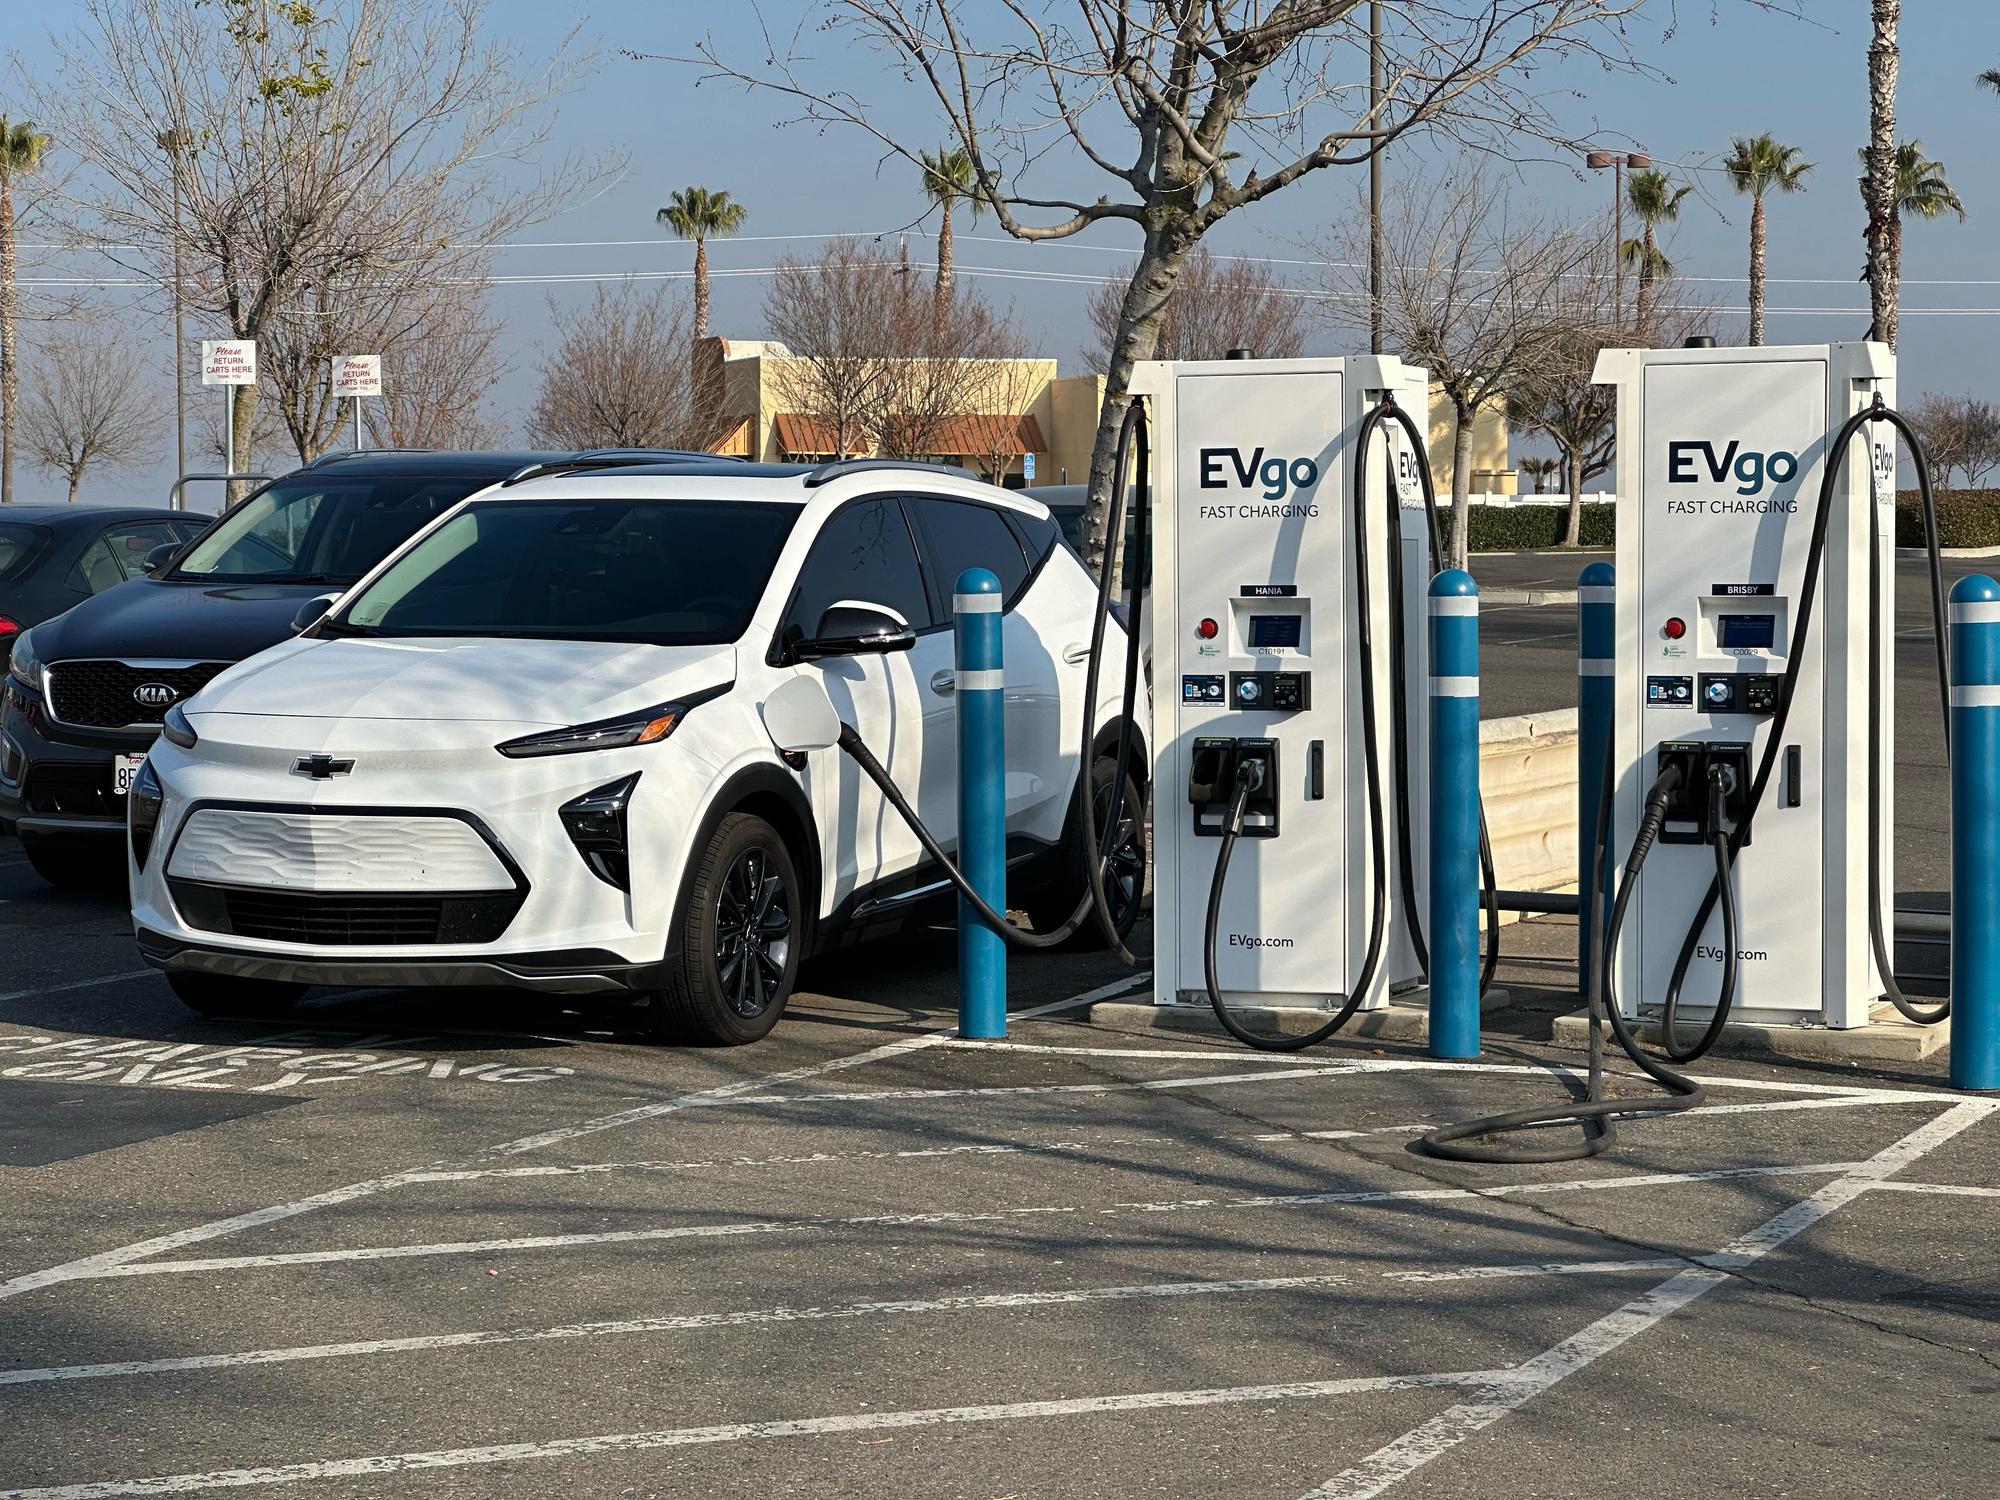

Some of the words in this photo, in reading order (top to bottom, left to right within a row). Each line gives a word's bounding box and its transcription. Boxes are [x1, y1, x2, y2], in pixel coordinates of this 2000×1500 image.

[215, 346, 242, 355] Please
[232, 365, 253, 373] HERE
[344, 361, 369, 369] Please
[342, 370, 370, 378] RETURN
[336, 378, 358, 386] CARTS
[1668, 440, 1798, 496] EVgo
[1874, 443, 1894, 480] EVgo
[1200, 446, 1319, 501] EVgo
[1200, 505, 1236, 519] FAST
[1238, 504, 1319, 518] CHARGING
[1667, 500, 1707, 514] FAST
[1710, 500, 1798, 514] CHARGING
[1255, 587, 1283, 595] HANIA
[1727, 586, 1758, 594] BRISBY
[139, 688, 169, 702] KIA
[1229, 934, 1294, 950] EVgo.com
[1697, 946, 1767, 962] EVgcom
[2, 1060, 359, 1092] ONLY
